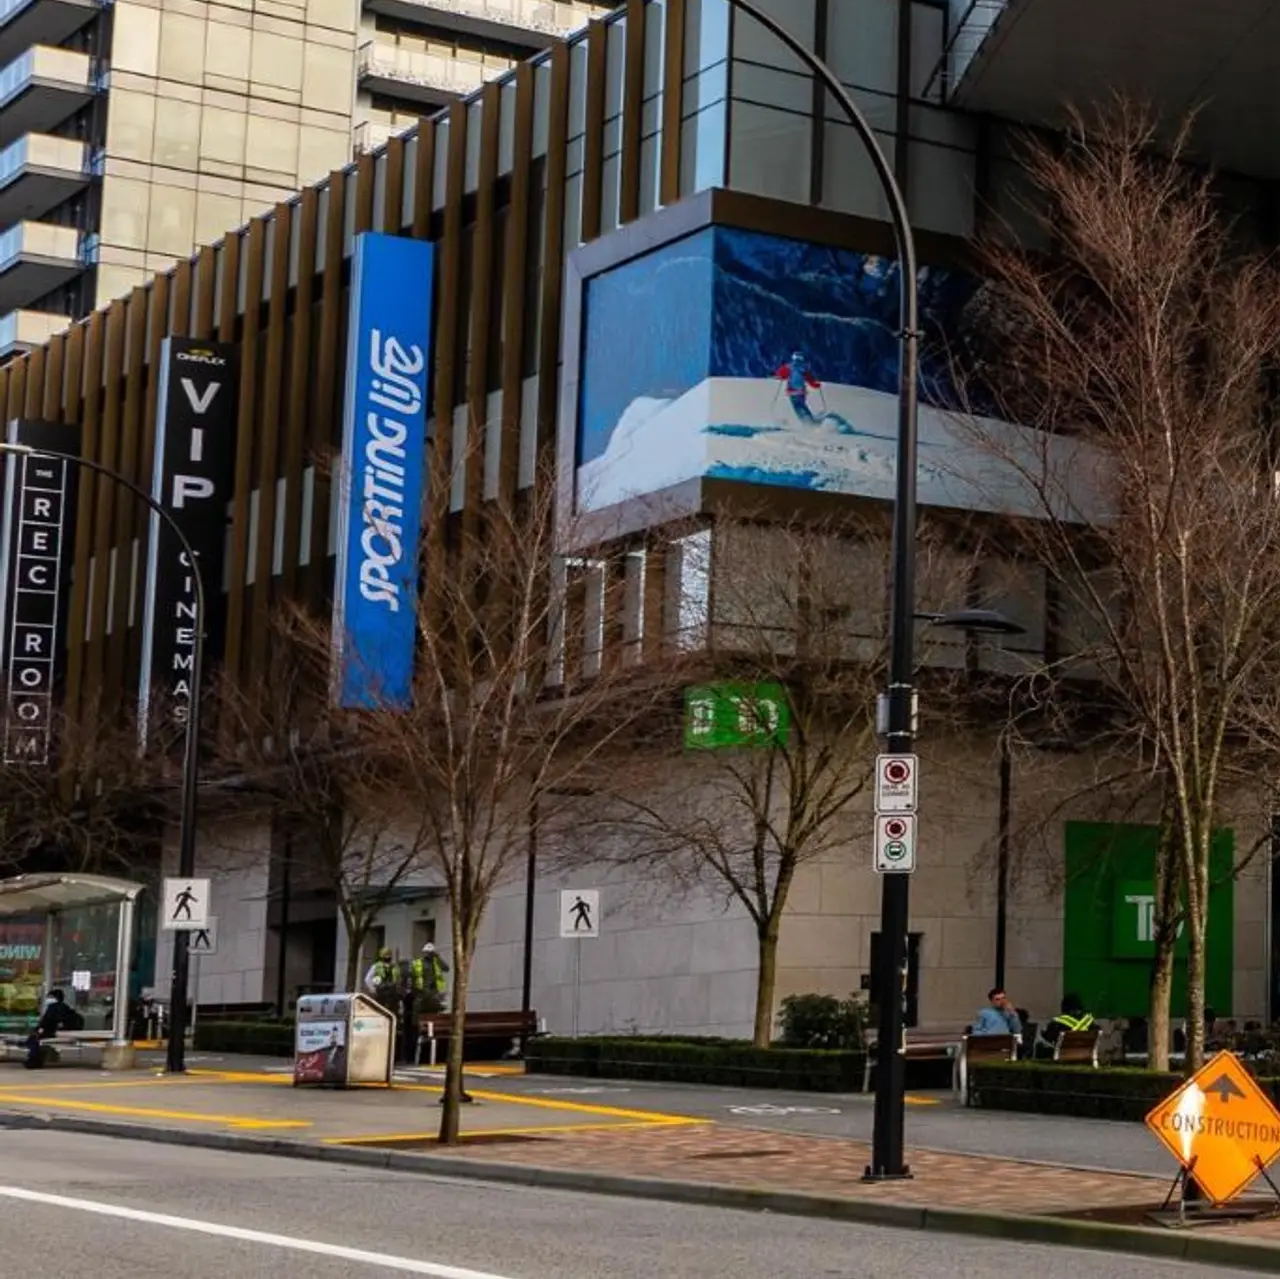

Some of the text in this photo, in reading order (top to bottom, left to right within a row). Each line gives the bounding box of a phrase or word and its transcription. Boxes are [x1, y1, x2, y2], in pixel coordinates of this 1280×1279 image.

[172, 377, 221, 509] VIP
[28, 497, 52, 584] REC
[15, 633, 42, 754] ROOM
[1161, 1111, 1280, 1144] CONSTRUCTION
